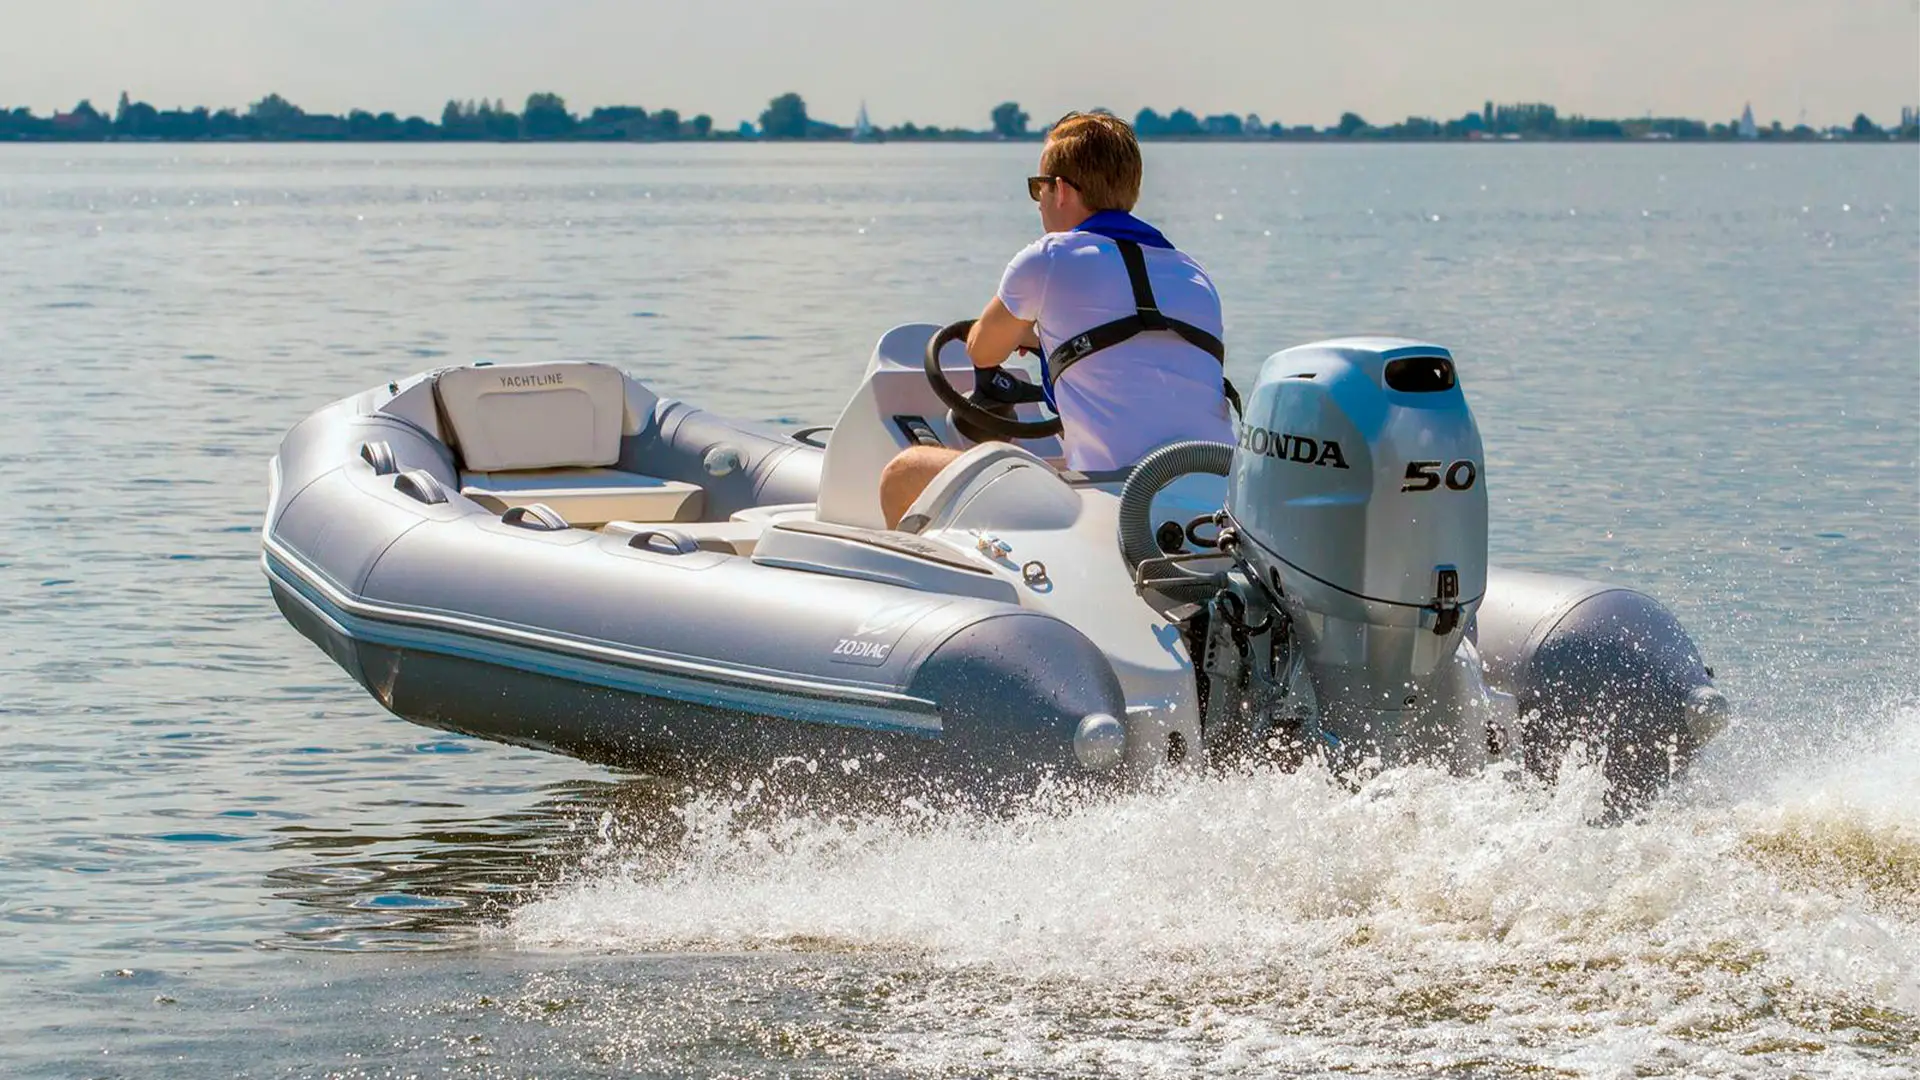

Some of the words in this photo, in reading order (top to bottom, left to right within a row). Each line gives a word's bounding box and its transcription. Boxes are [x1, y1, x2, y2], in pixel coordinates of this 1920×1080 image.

[500, 373, 564, 387] YACHTLINE
[1238, 421, 1349, 469] HONDA
[1401, 459, 1476, 492] 50
[833, 639, 890, 658] ZODIAC
